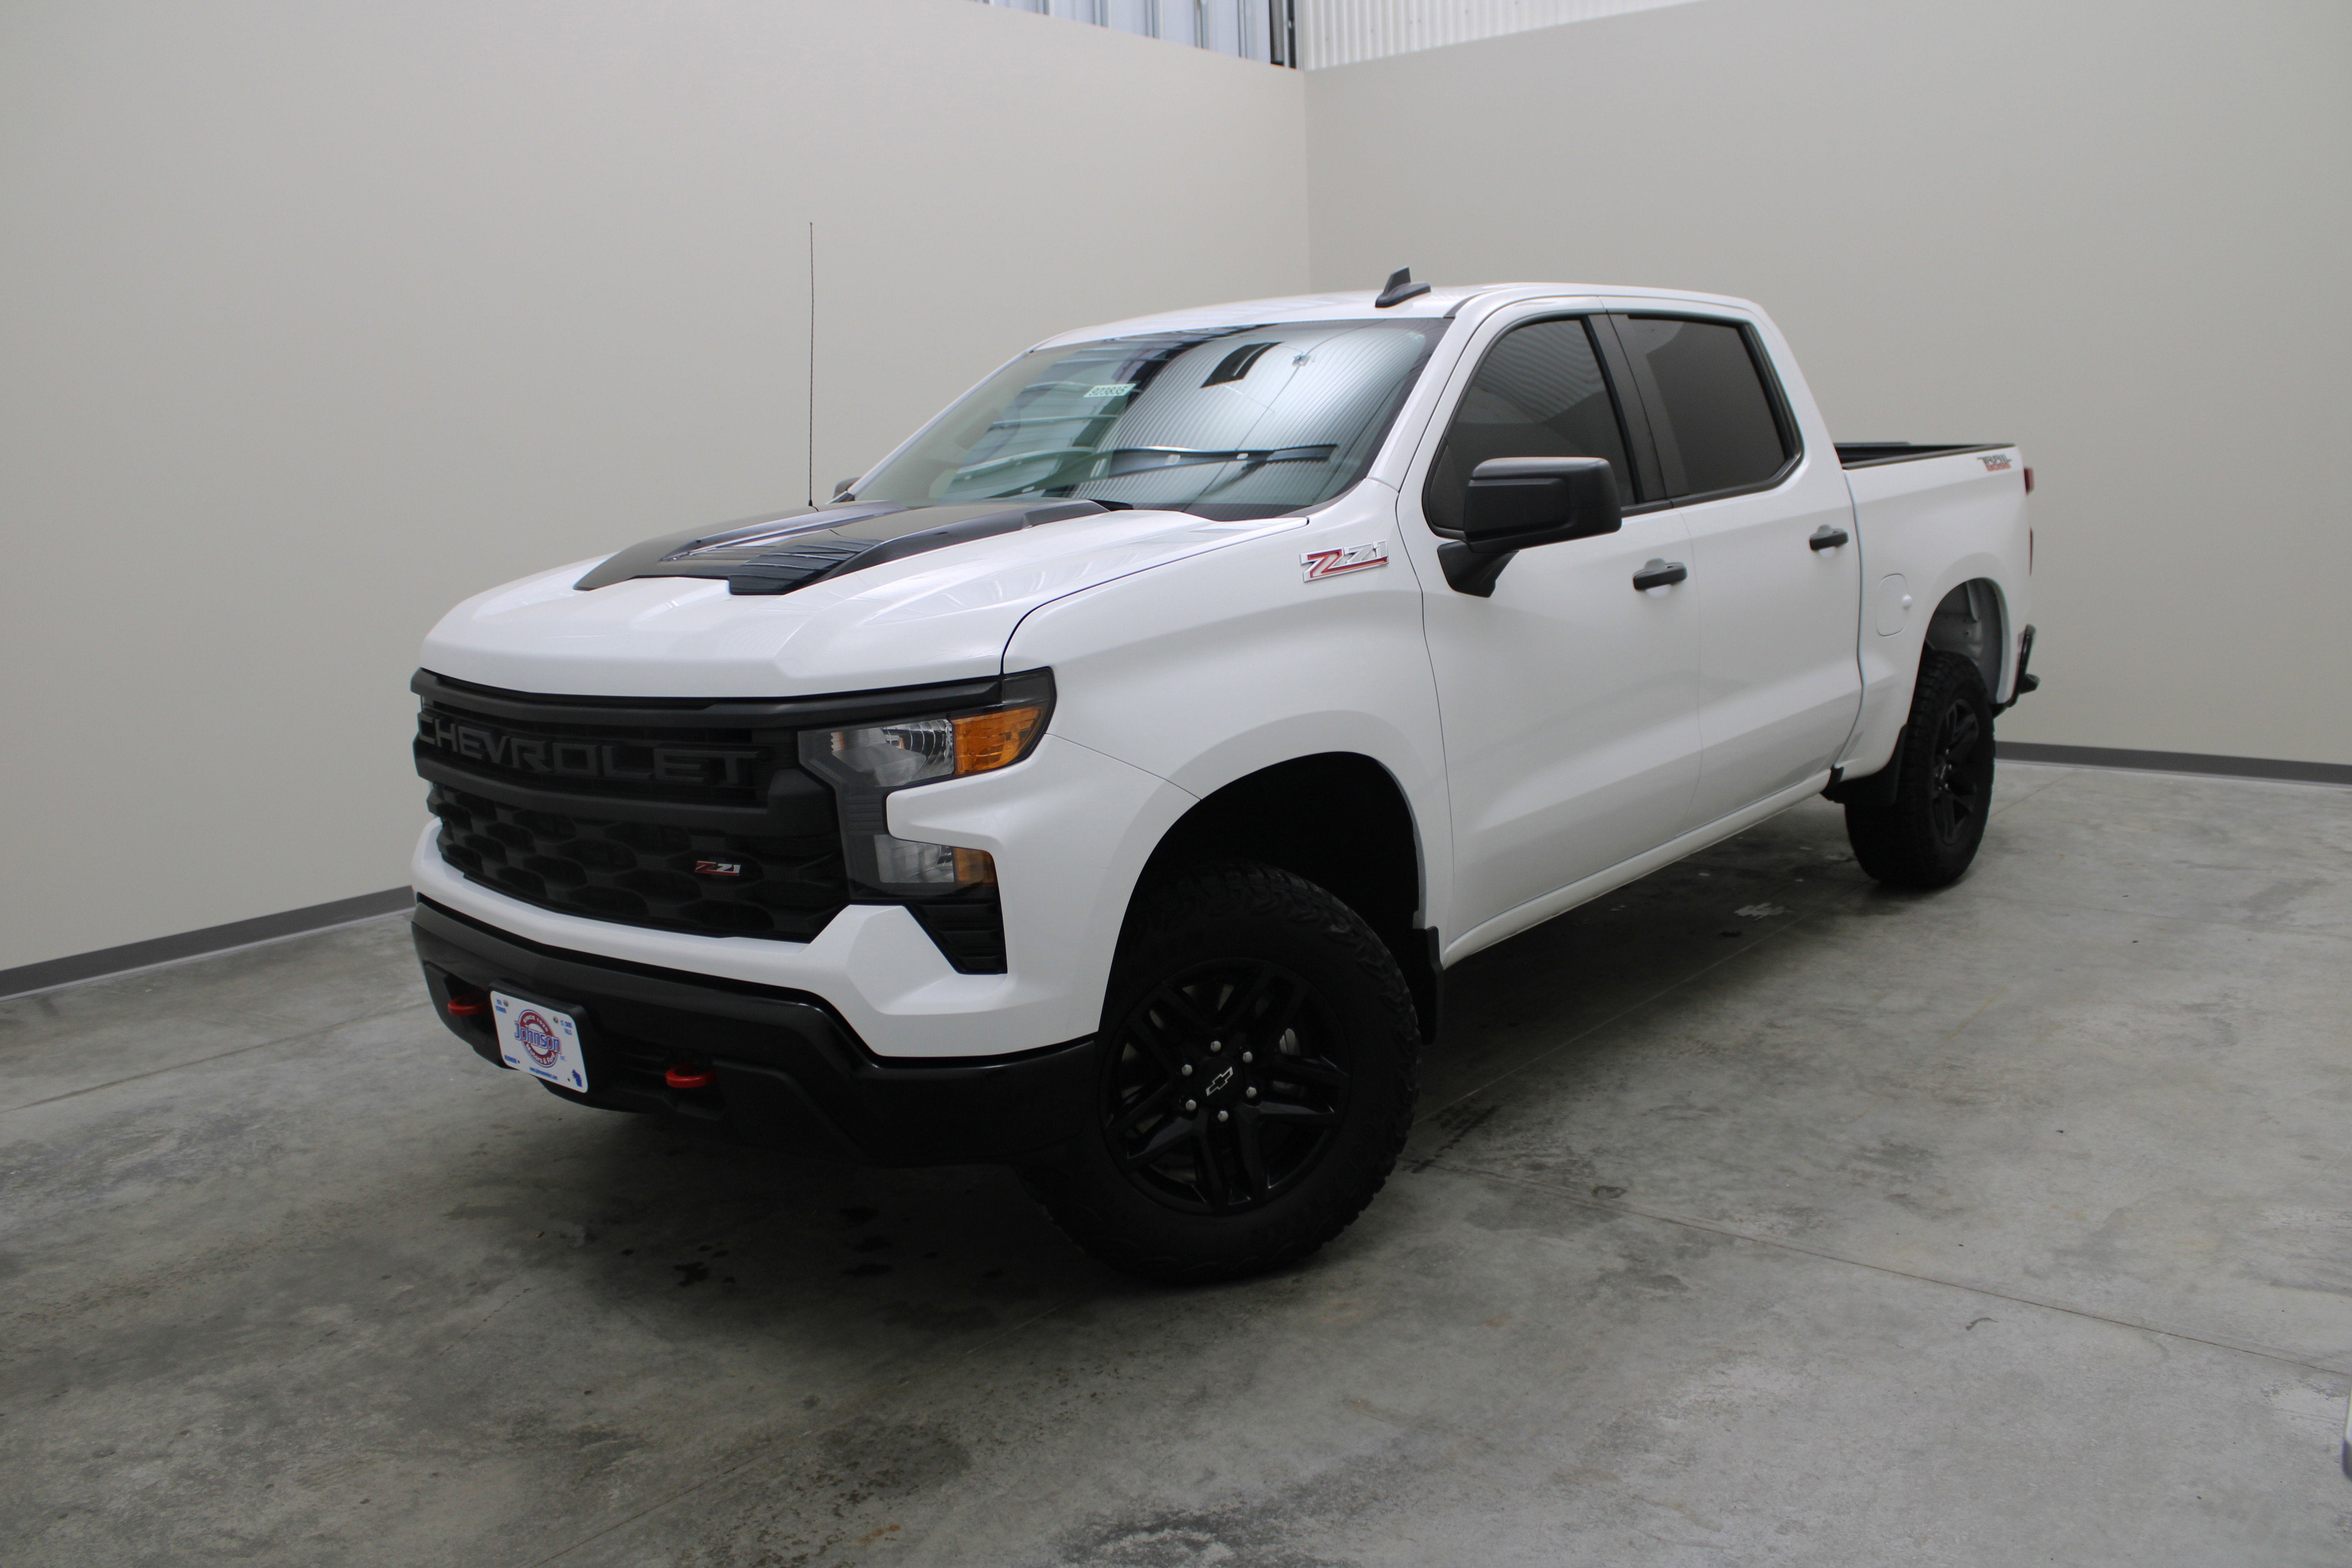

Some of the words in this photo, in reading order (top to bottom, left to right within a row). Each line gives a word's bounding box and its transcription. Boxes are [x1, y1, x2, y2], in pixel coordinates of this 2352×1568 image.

[1299, 539, 1388, 583] Z71
[417, 712, 765, 784] CHEVROLET
[695, 861, 741, 876] Z71
[514, 1021, 561, 1053] Johnson
